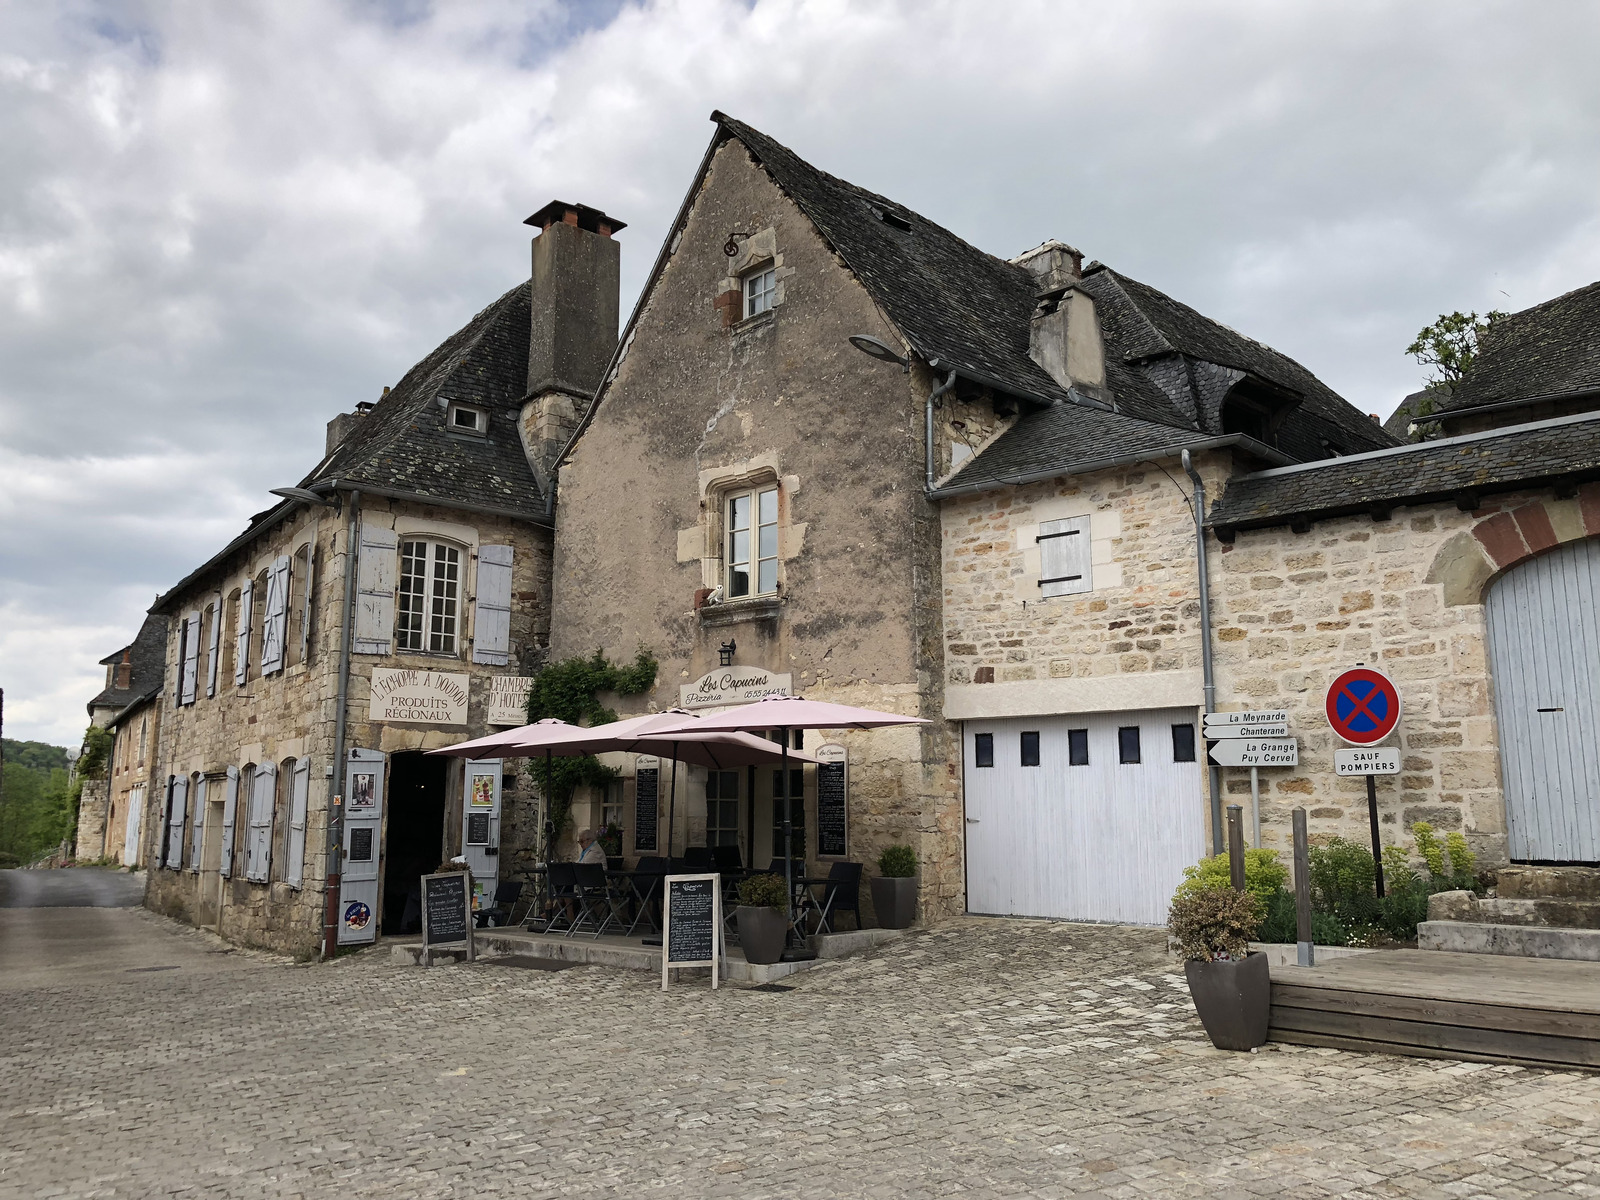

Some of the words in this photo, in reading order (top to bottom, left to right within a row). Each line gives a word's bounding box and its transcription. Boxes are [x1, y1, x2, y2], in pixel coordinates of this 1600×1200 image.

[699, 675, 718, 693] Les
[720, 673, 768, 692] Capucins
[1229, 714, 1239, 722] La
[1243, 712, 1286, 722] Meynarde
[1240, 727, 1285, 736] Chanterane
[1246, 743, 1257, 752] La
[1261, 742, 1295, 753] Grange
[1241, 754, 1259, 764] Puy
[1263, 753, 1295, 762] Cervel
[1353, 752, 1380, 761] SAUF
[1340, 762, 1395, 772] POMPIERS
